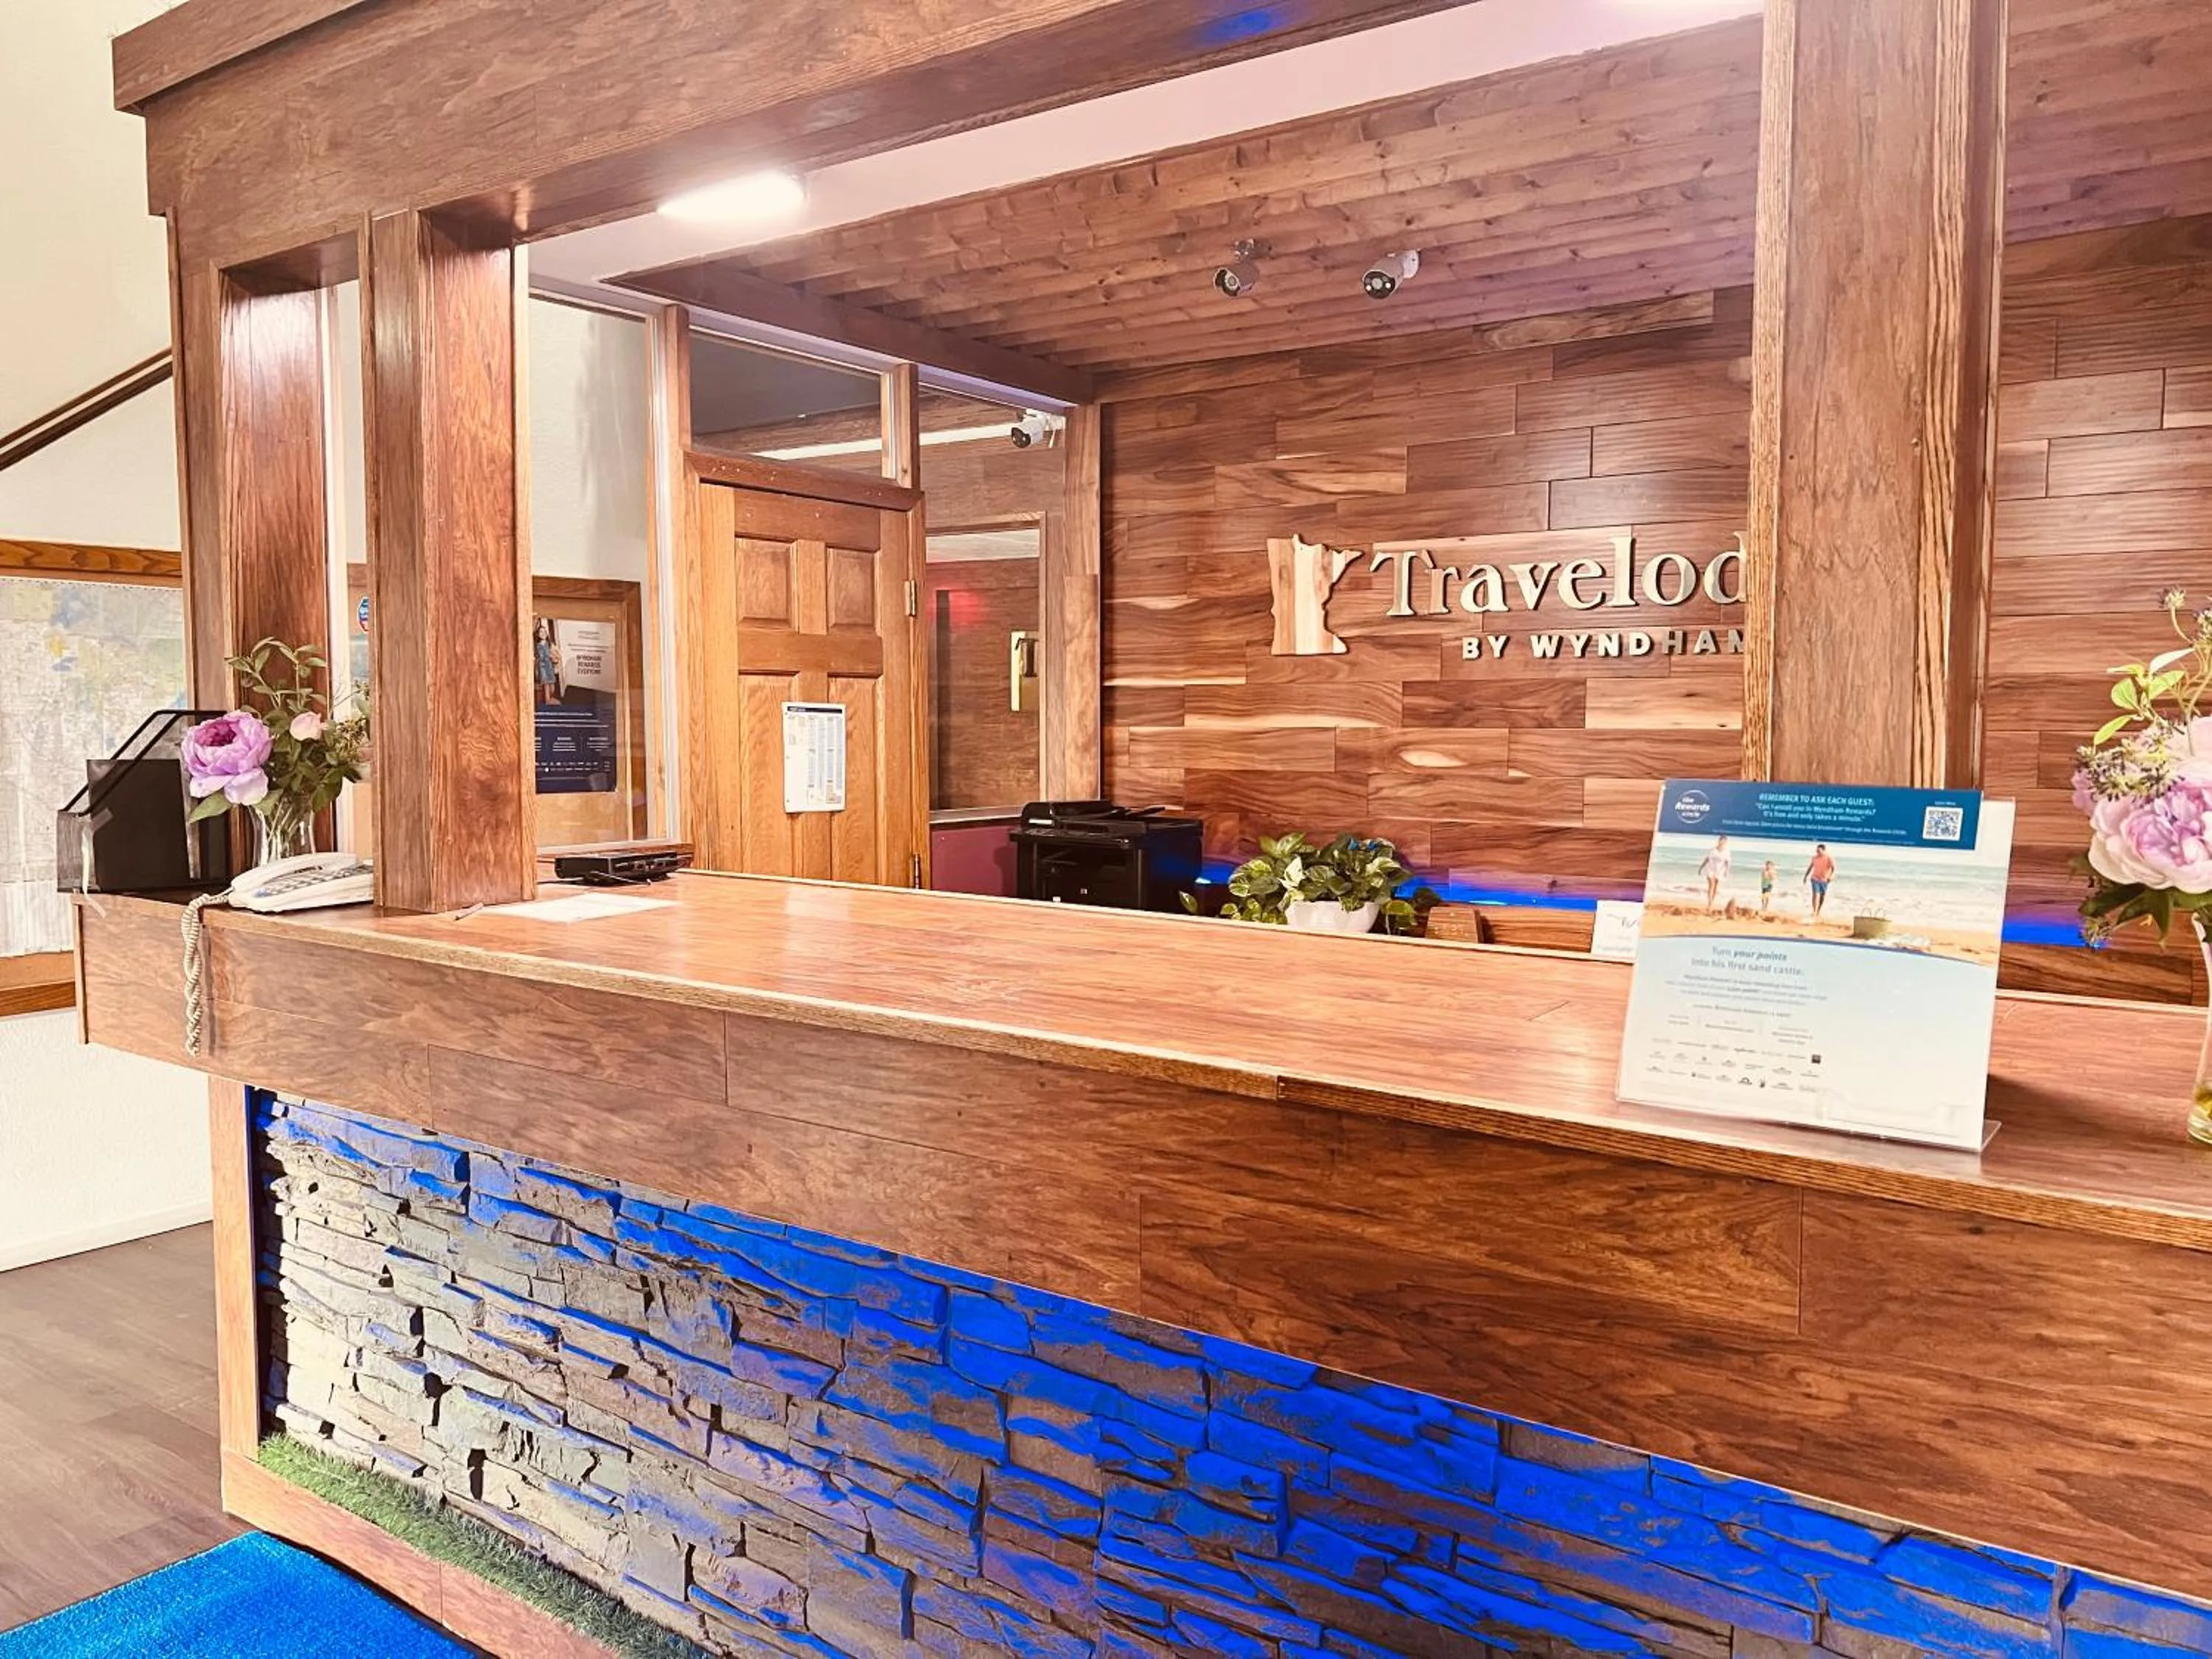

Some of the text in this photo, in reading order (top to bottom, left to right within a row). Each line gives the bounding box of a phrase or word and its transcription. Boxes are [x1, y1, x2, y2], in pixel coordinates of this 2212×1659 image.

[1462, 635, 1509, 659] BY
[1759, 793, 1875, 806] REMEMBER TO ASK EACH GUEST:
[1712, 945, 1787, 961] Turn your points
[1711, 959, 1725, 968] his
[1728, 960, 1746, 970] first
[1748, 964, 1771, 973] sand
